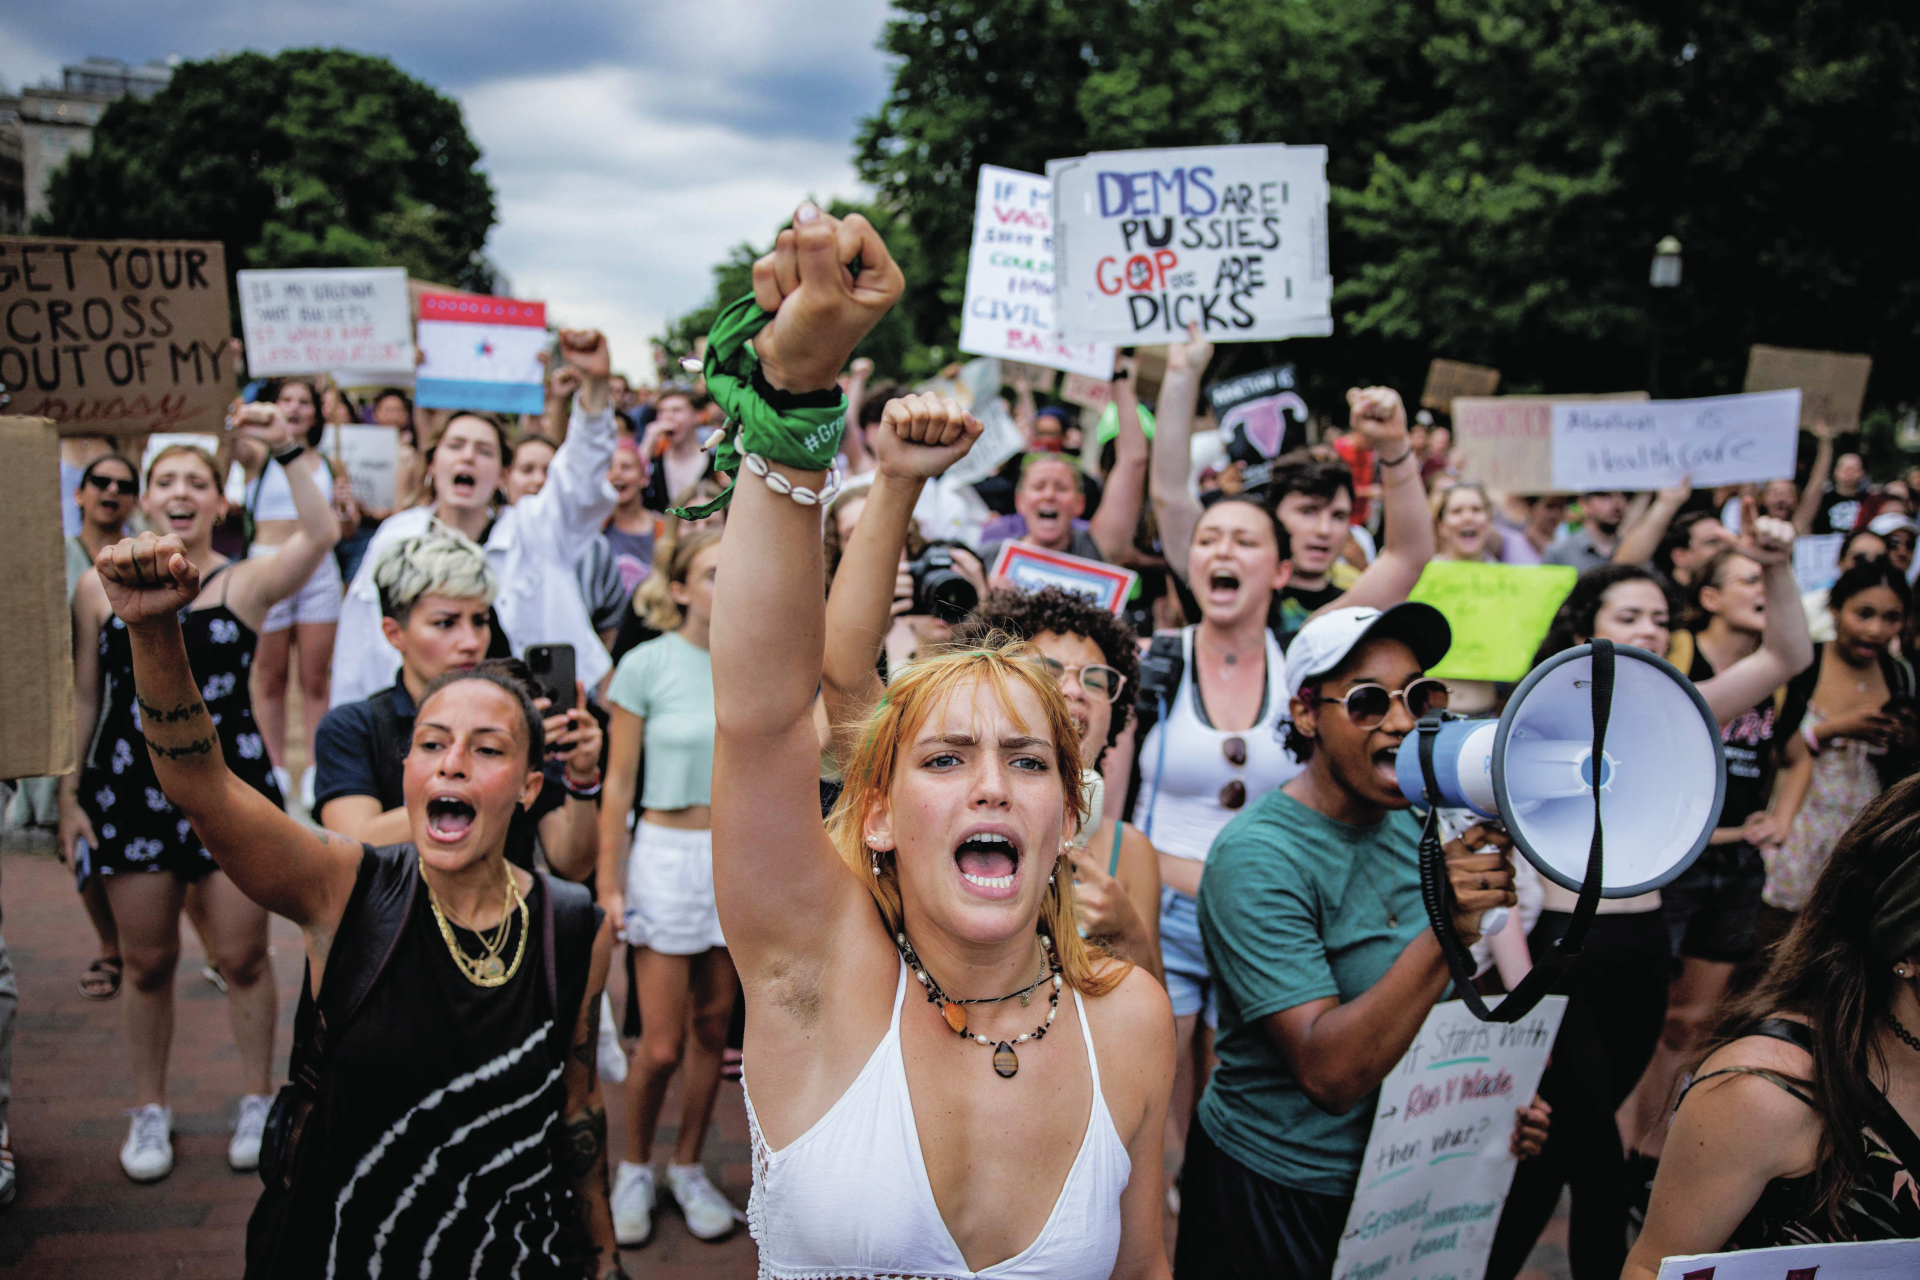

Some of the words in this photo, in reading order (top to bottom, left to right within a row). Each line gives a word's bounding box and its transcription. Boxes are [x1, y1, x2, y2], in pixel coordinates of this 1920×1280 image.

[1097, 166, 1217, 218] DEMS
[1120, 216, 1280, 252] PUSSIES
[96, 245, 209, 291] YOUR
[1215, 256, 1266, 290] ARE
[6, 296, 173, 344] CROSS
[1127, 289, 1256, 332] DICKS
[0, 344, 89, 392] OUT
[105, 342, 155, 386] OF
[169, 339, 229, 385] MY
[1403, 1082, 1441, 1123] Roe
